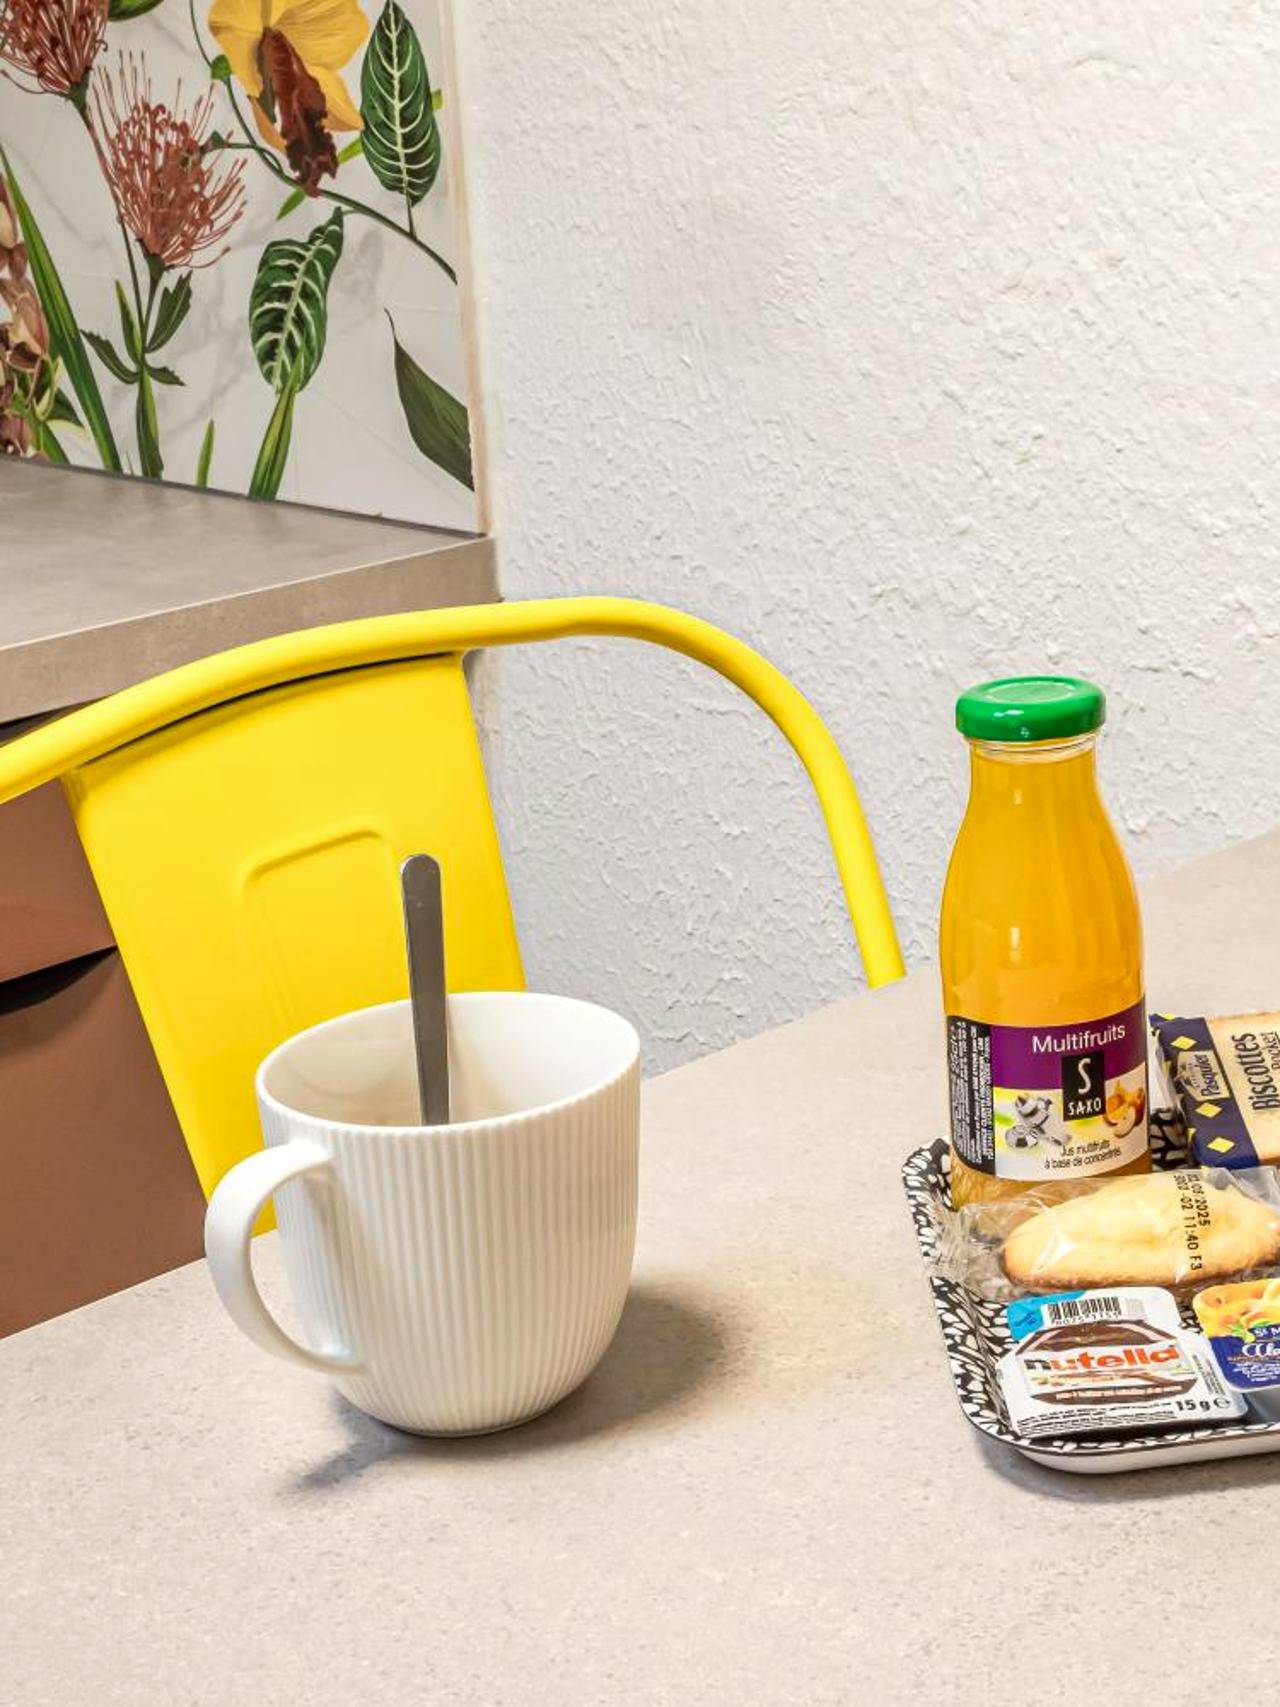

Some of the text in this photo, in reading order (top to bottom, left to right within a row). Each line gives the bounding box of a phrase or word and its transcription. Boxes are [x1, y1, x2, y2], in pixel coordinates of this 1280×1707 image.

[1031, 1024, 1126, 1054] Multifruits
[1077, 1057, 1092, 1096] S
[1067, 1099, 1102, 1116] SAXO
[1183, 1216, 1199, 1250] 11:40
[1190, 1255, 1202, 1270] F3
[1024, 1345, 1179, 1371] nutella
[1175, 1399, 1211, 1412] 15 g
